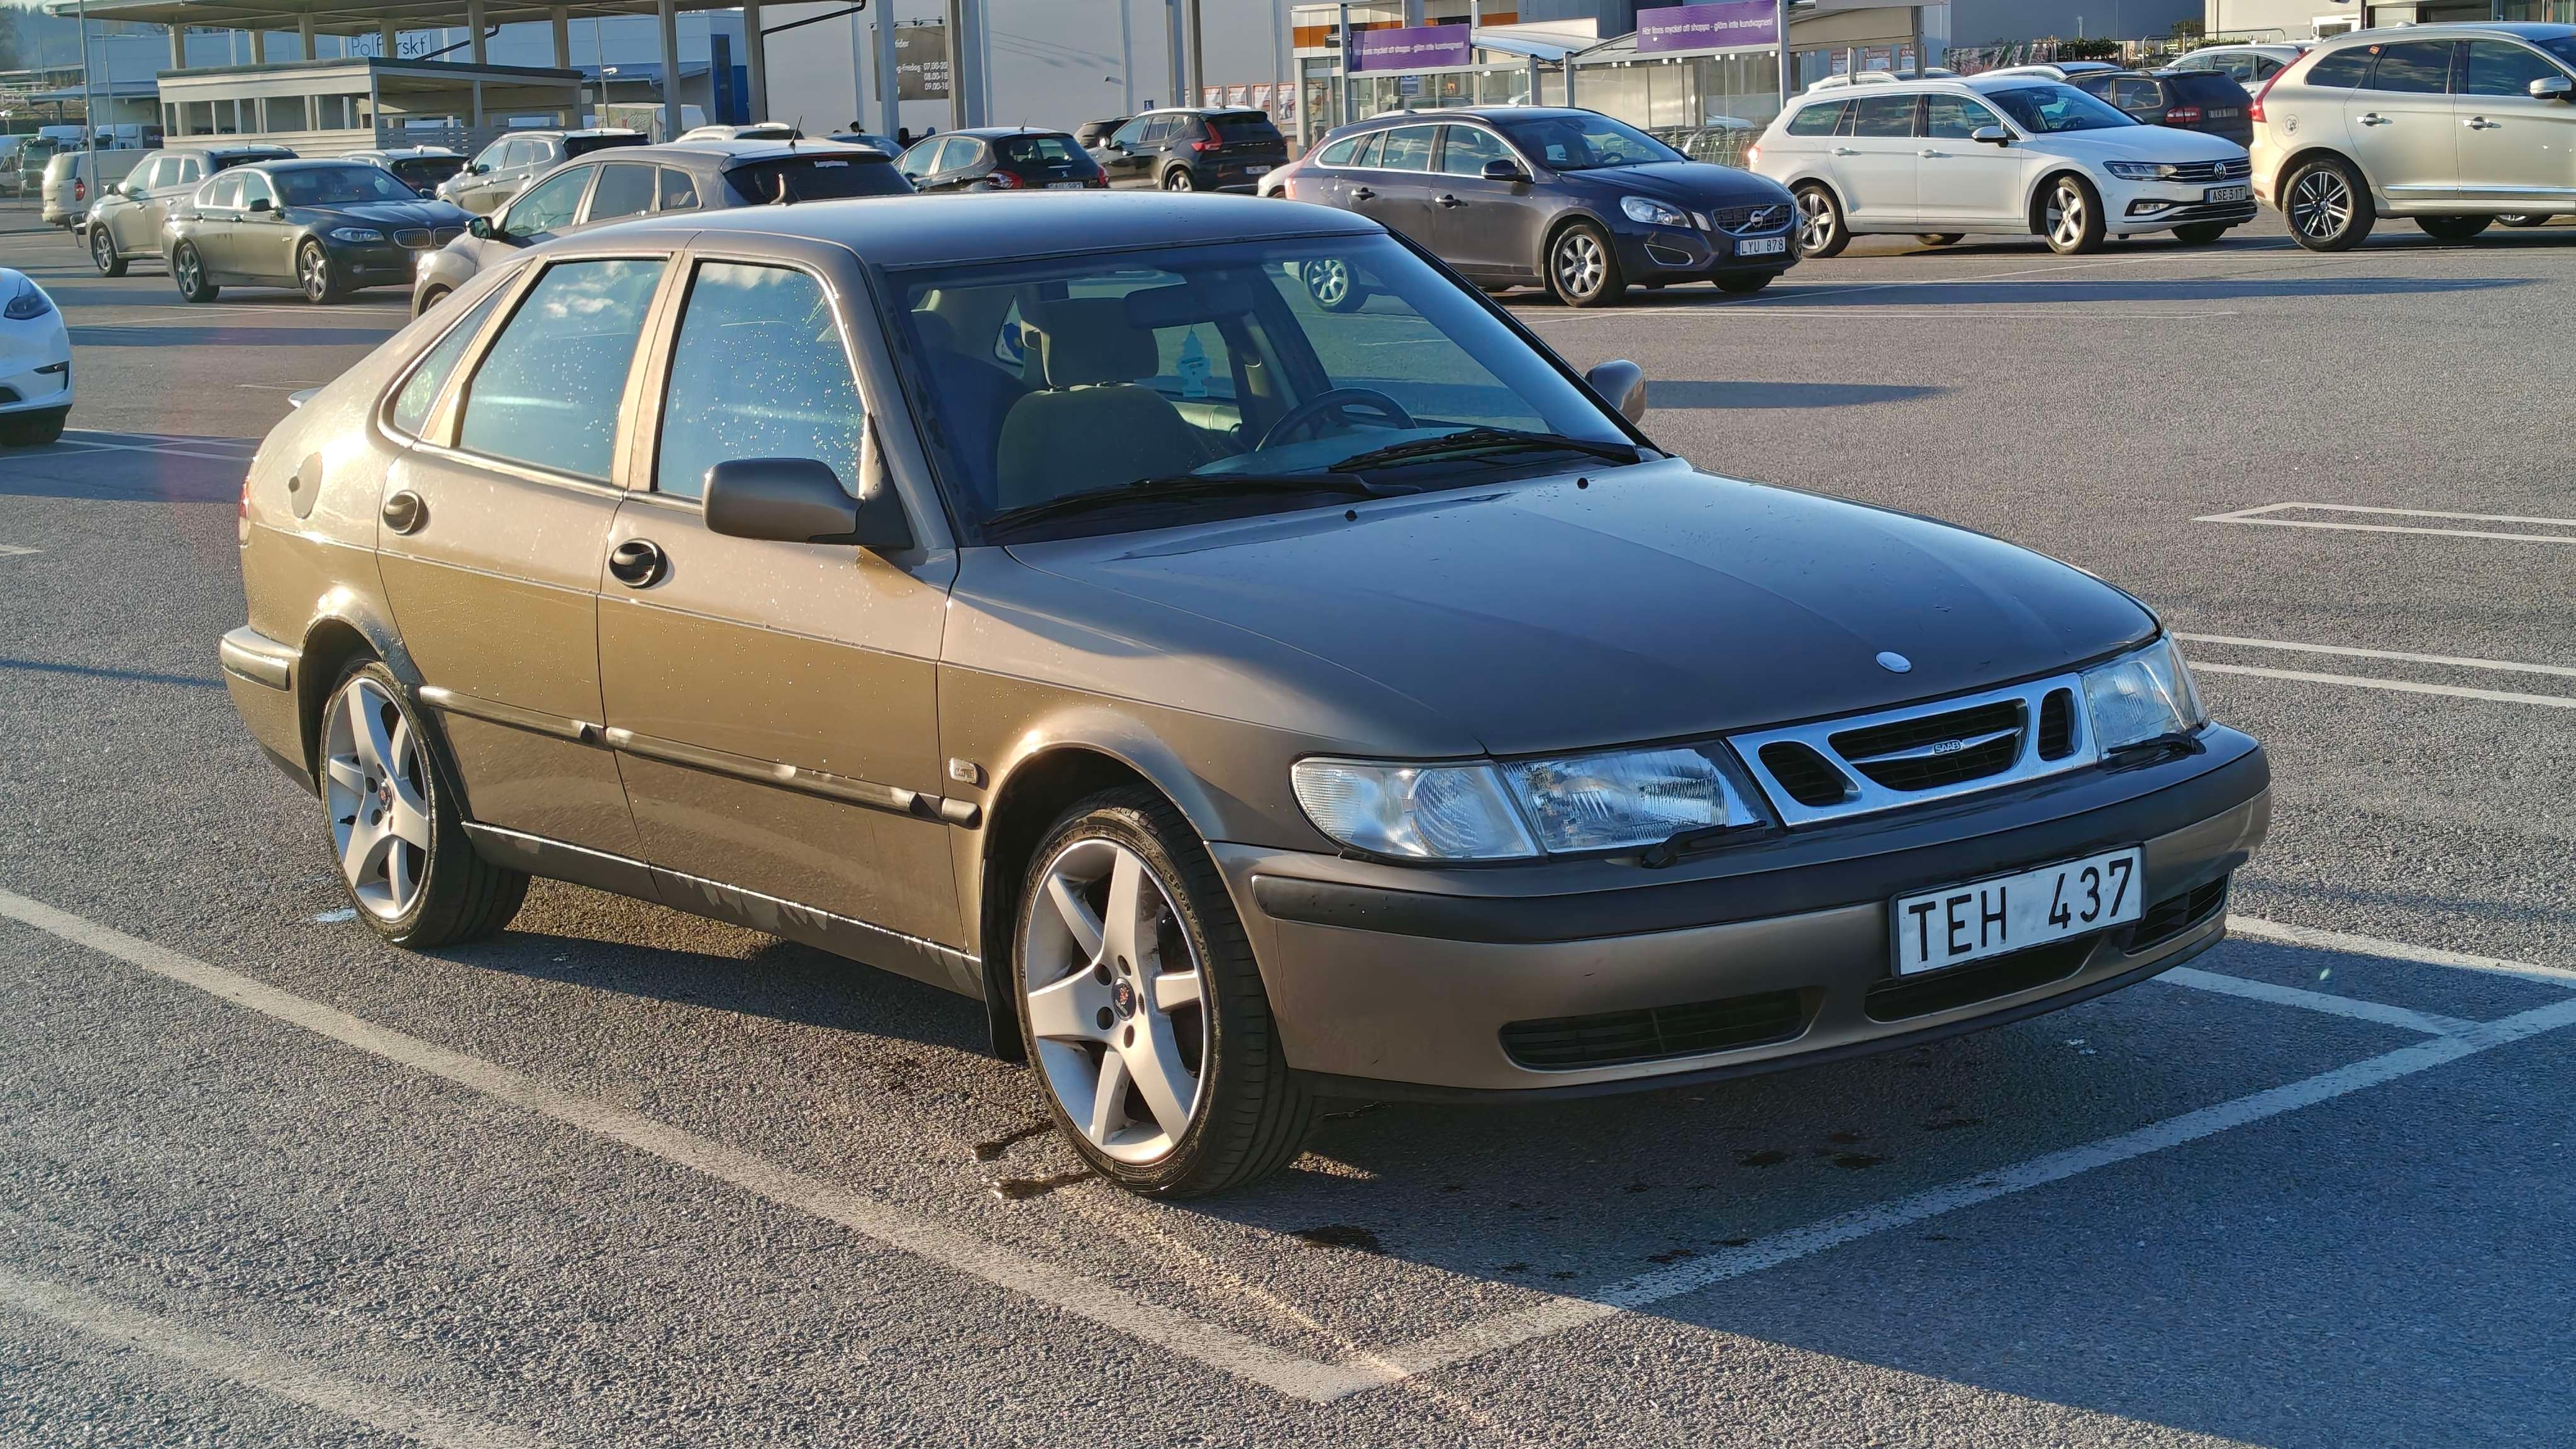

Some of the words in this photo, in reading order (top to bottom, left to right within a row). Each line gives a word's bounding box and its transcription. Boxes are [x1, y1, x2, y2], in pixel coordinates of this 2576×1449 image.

[2214, 189, 2226, 201] ASE
[1741, 241, 1760, 254] LYU
[1935, 742, 1960, 753] SAAB
[1908, 886, 2006, 962] TEH
[2048, 857, 2133, 930] 437
